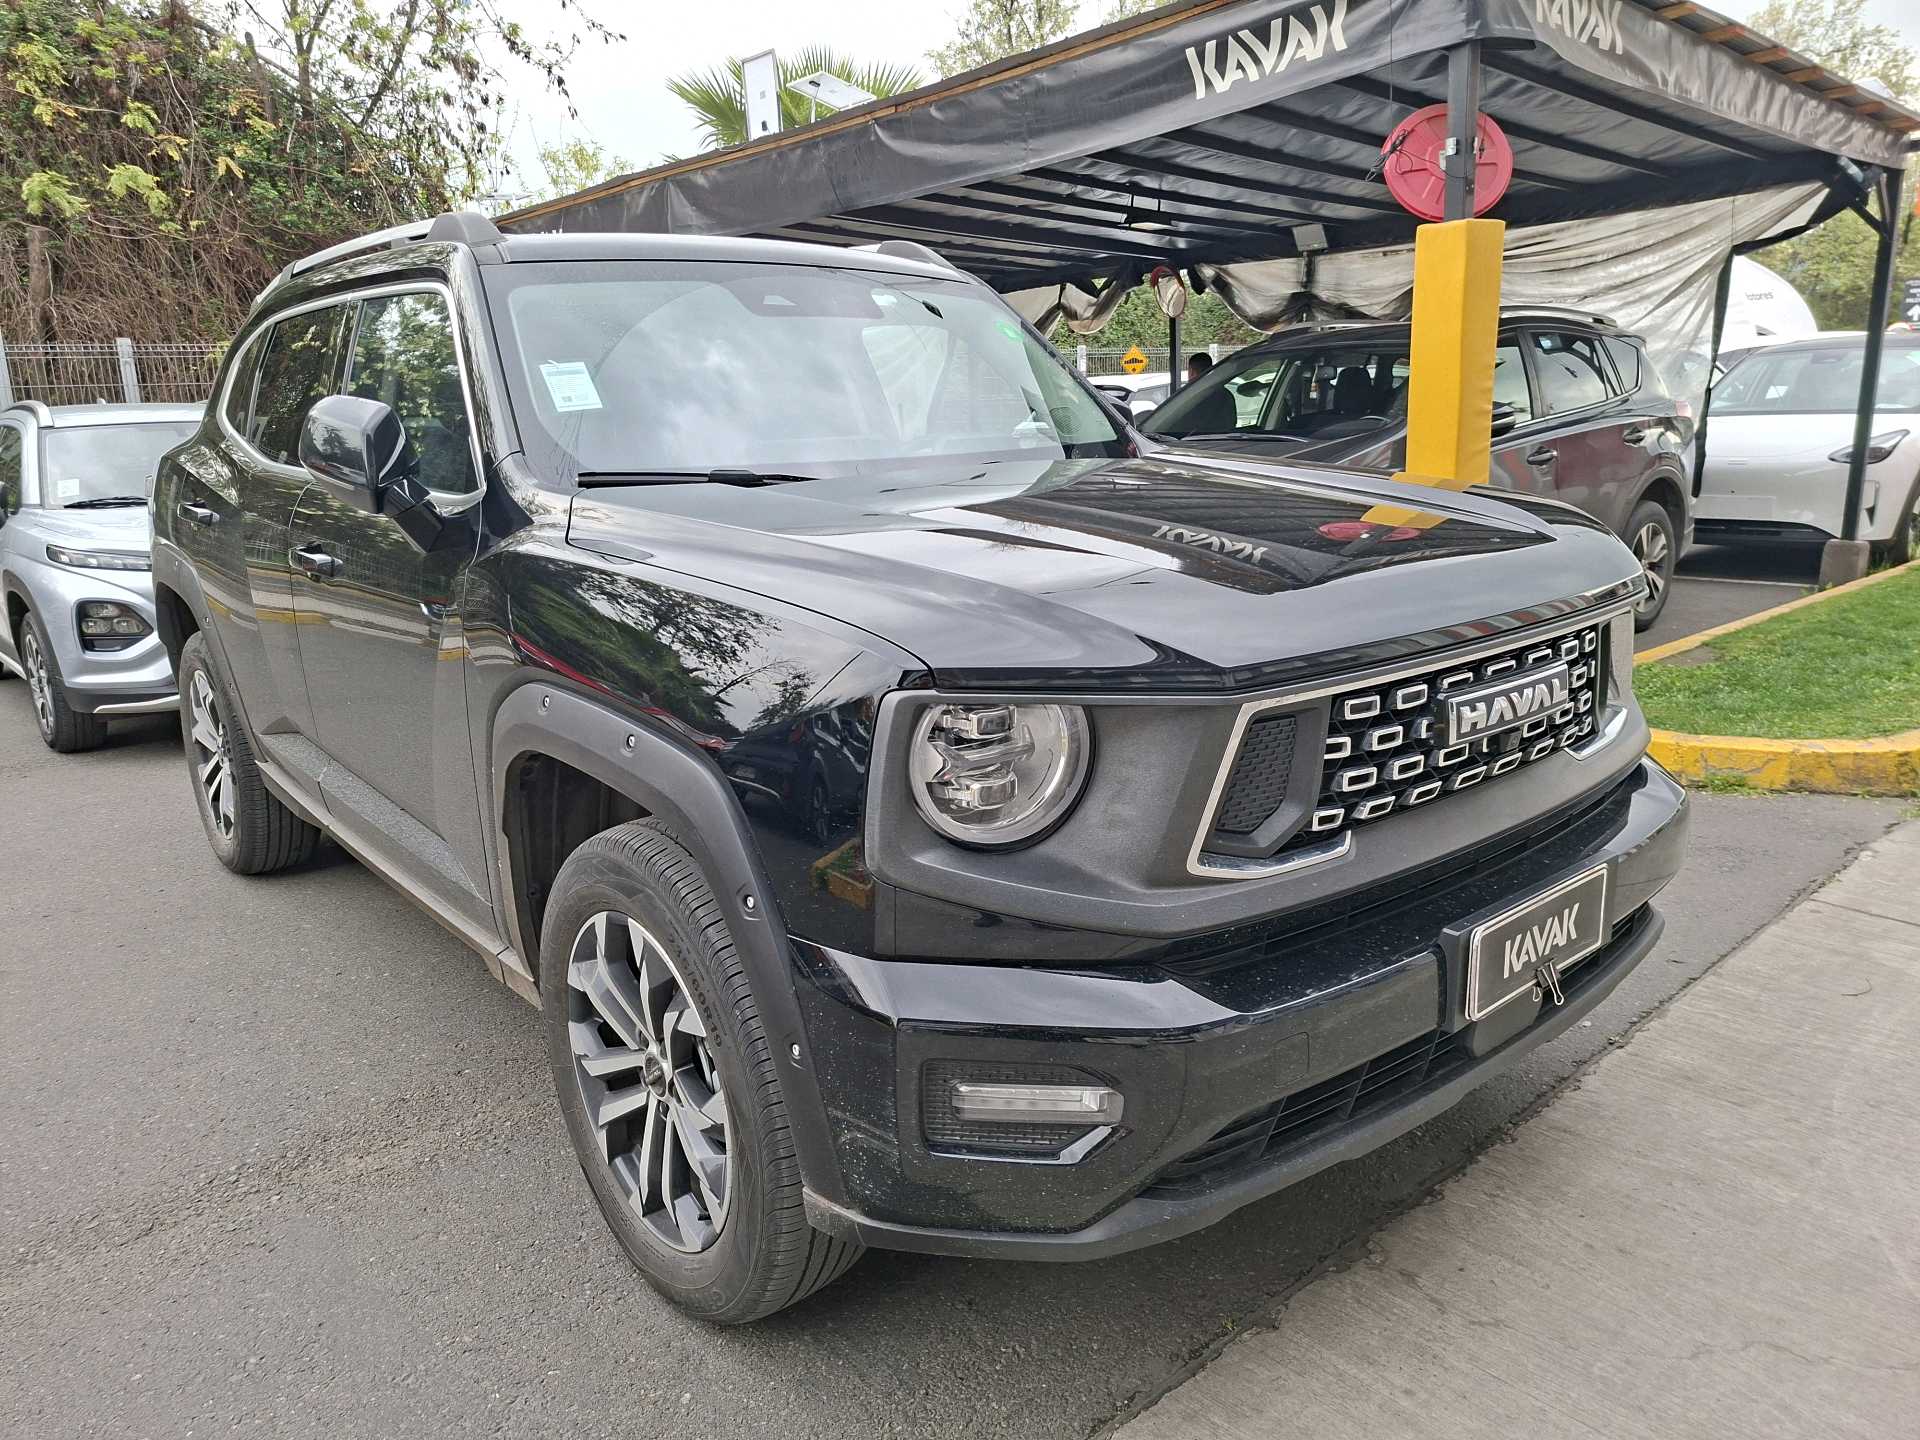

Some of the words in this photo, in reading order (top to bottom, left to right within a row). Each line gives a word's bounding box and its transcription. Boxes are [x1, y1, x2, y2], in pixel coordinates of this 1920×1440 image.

[1185, 0, 1348, 100] KAVAK
[1460, 678, 1568, 733] HAVAL
[1503, 902, 1580, 979] KAVAK
